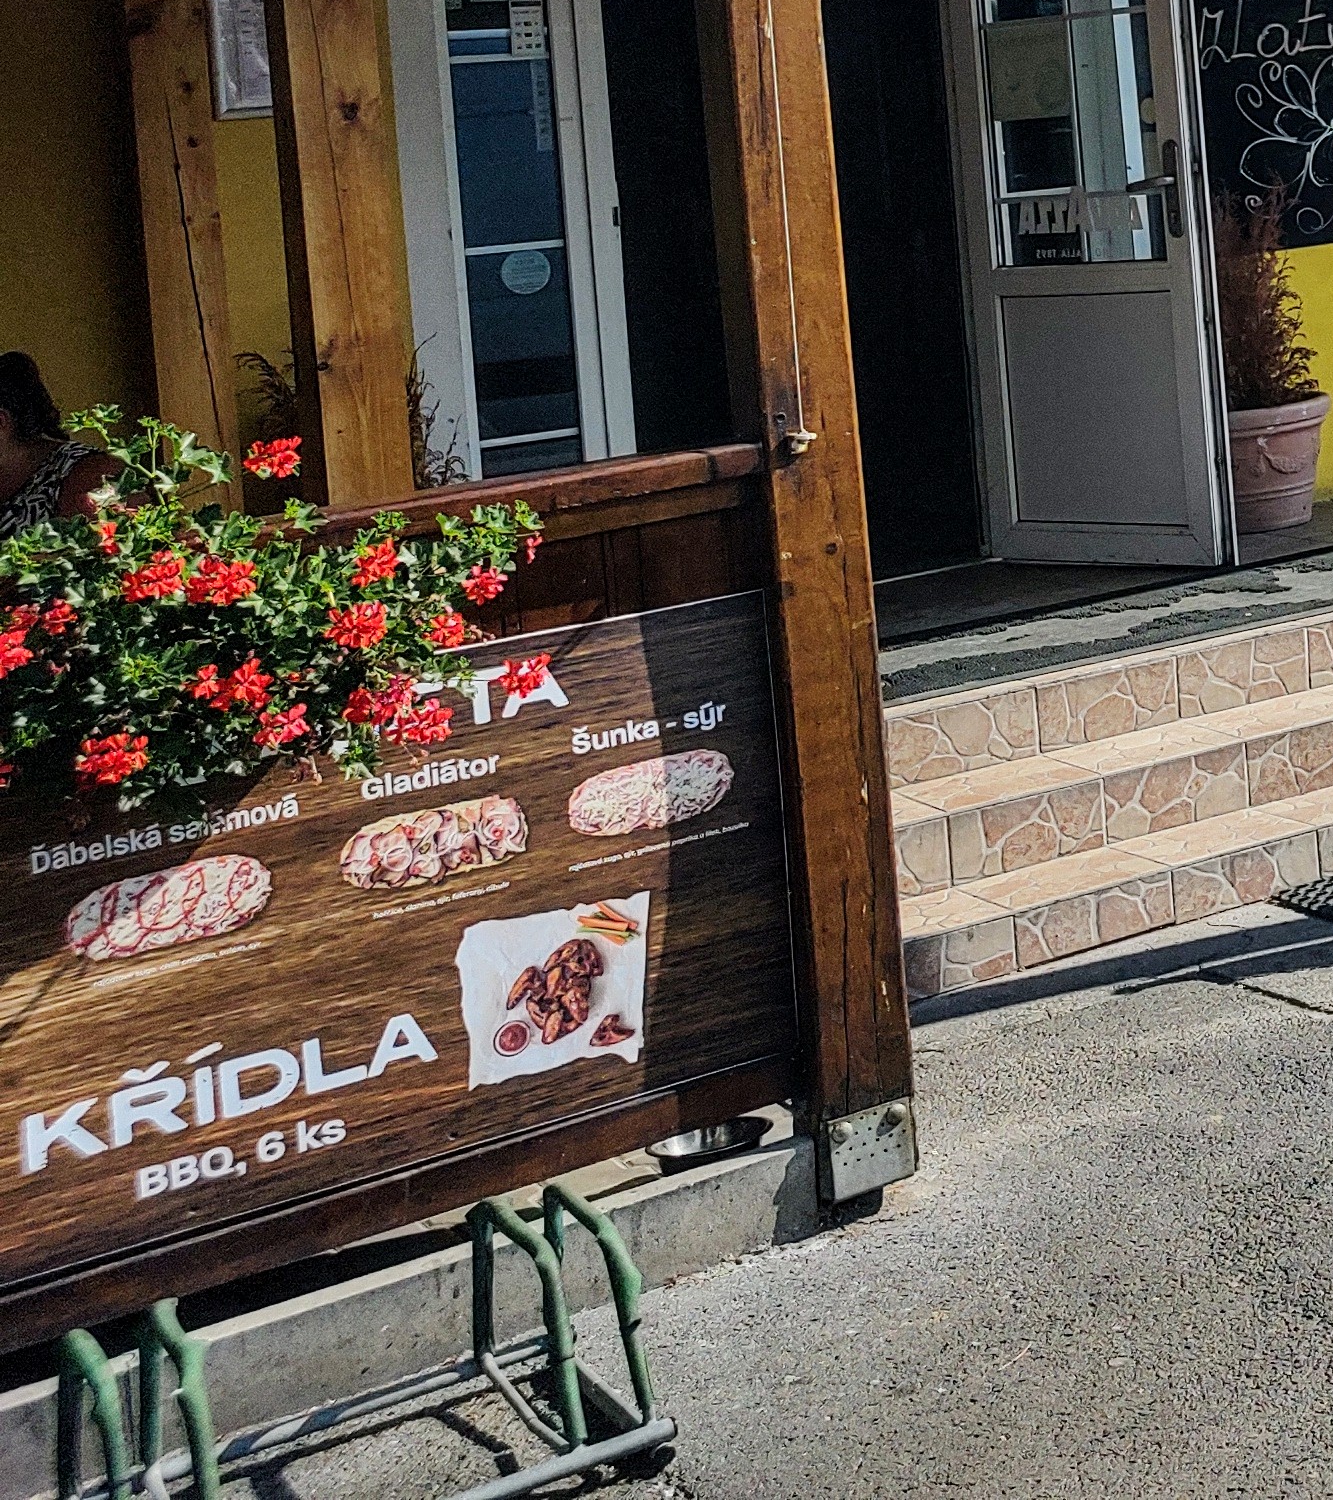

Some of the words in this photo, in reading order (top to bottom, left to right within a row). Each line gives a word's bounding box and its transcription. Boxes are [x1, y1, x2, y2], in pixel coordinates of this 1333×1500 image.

[571, 720, 660, 755] Šunka
[683, 700, 726, 731] sýr
[361, 754, 500, 800] Gladiátor
[30, 823, 162, 875] Ďábelská
[21, 1013, 439, 1176] KŘÍDLA
[137, 1146, 247, 1200] BBQ,
[257, 1131, 286, 1162] 6
[297, 1118, 347, 1154] ks
